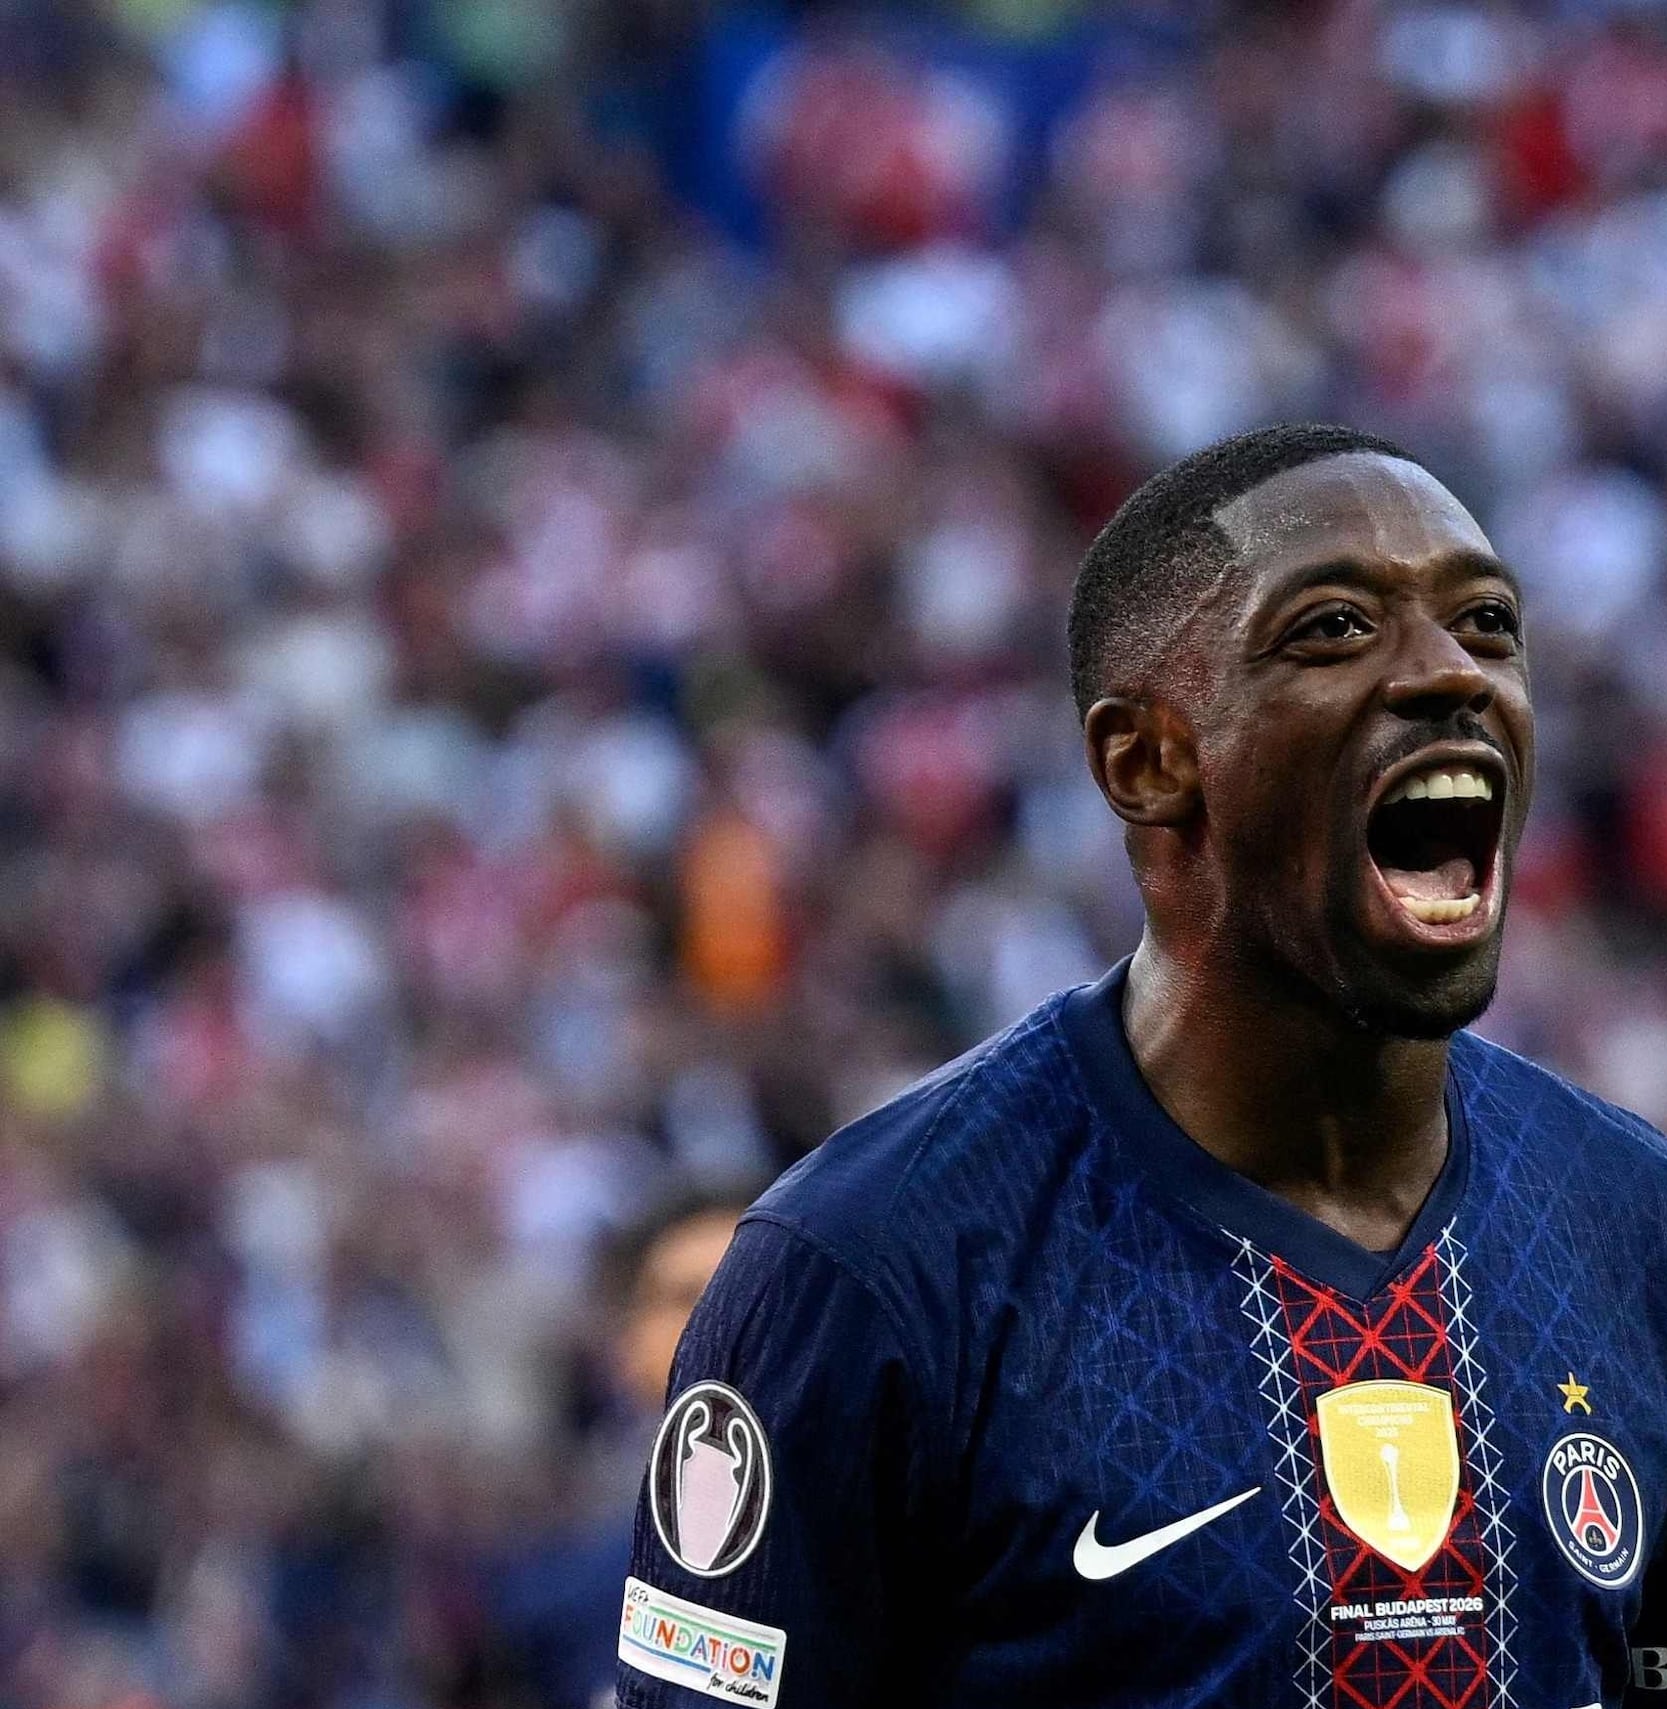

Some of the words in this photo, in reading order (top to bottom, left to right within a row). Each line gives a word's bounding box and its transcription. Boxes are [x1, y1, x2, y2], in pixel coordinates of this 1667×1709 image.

[1553, 1441, 1620, 1480] PARIS
[1330, 1604, 1373, 1620] FINAL
[1375, 1599, 1447, 1616] BUDAPEST
[1449, 1597, 1484, 1611] 2026
[707, 1672, 722, 1690] for
[725, 1680, 769, 1702] children
